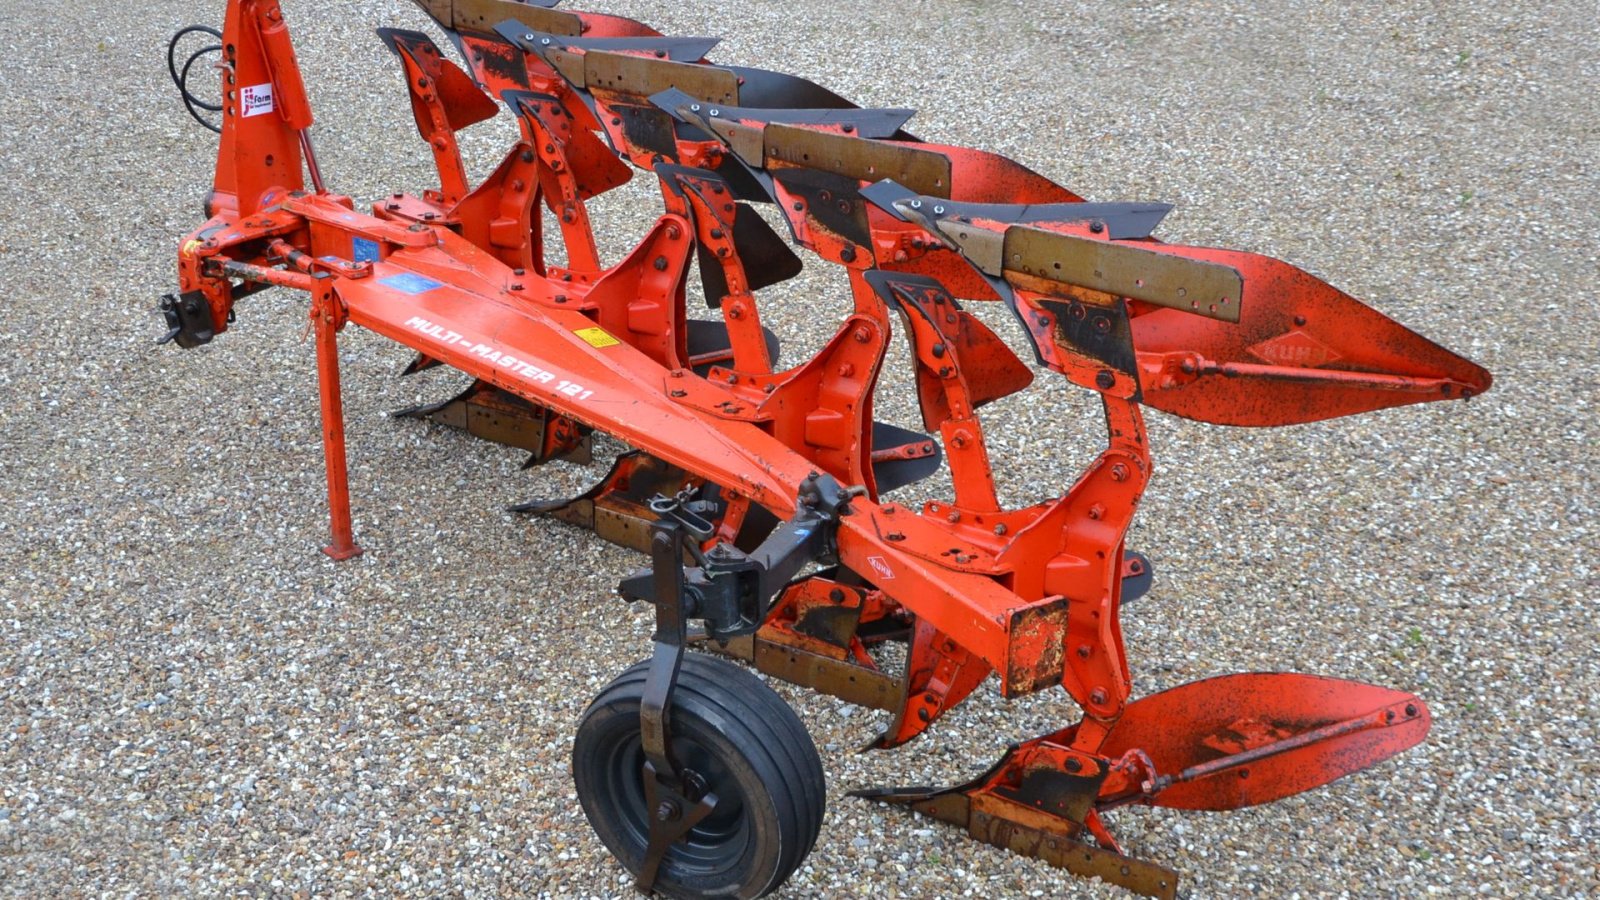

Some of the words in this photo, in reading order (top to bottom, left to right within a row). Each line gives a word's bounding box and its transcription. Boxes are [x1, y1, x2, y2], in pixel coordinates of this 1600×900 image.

[1263, 343, 1328, 361] KUHN
[555, 380, 595, 401] 121
[869, 558, 892, 577] KUHN
